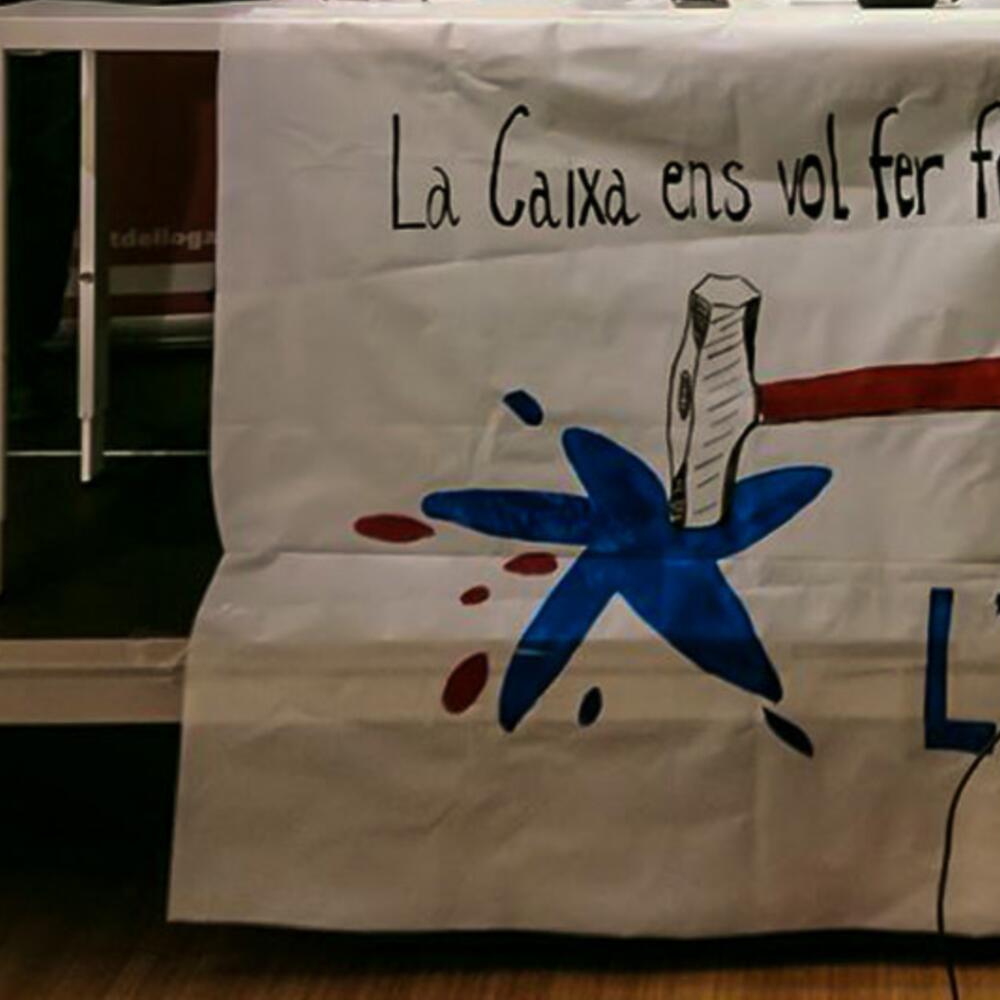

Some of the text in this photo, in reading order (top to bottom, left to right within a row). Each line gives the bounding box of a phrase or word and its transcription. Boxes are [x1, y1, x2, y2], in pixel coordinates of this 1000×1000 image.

[392, 112, 461, 230] La
[489, 103, 641, 230] Caixa
[661, 158, 752, 224] ens
[777, 111, 850, 222] vol
[869, 106, 945, 221] fer
